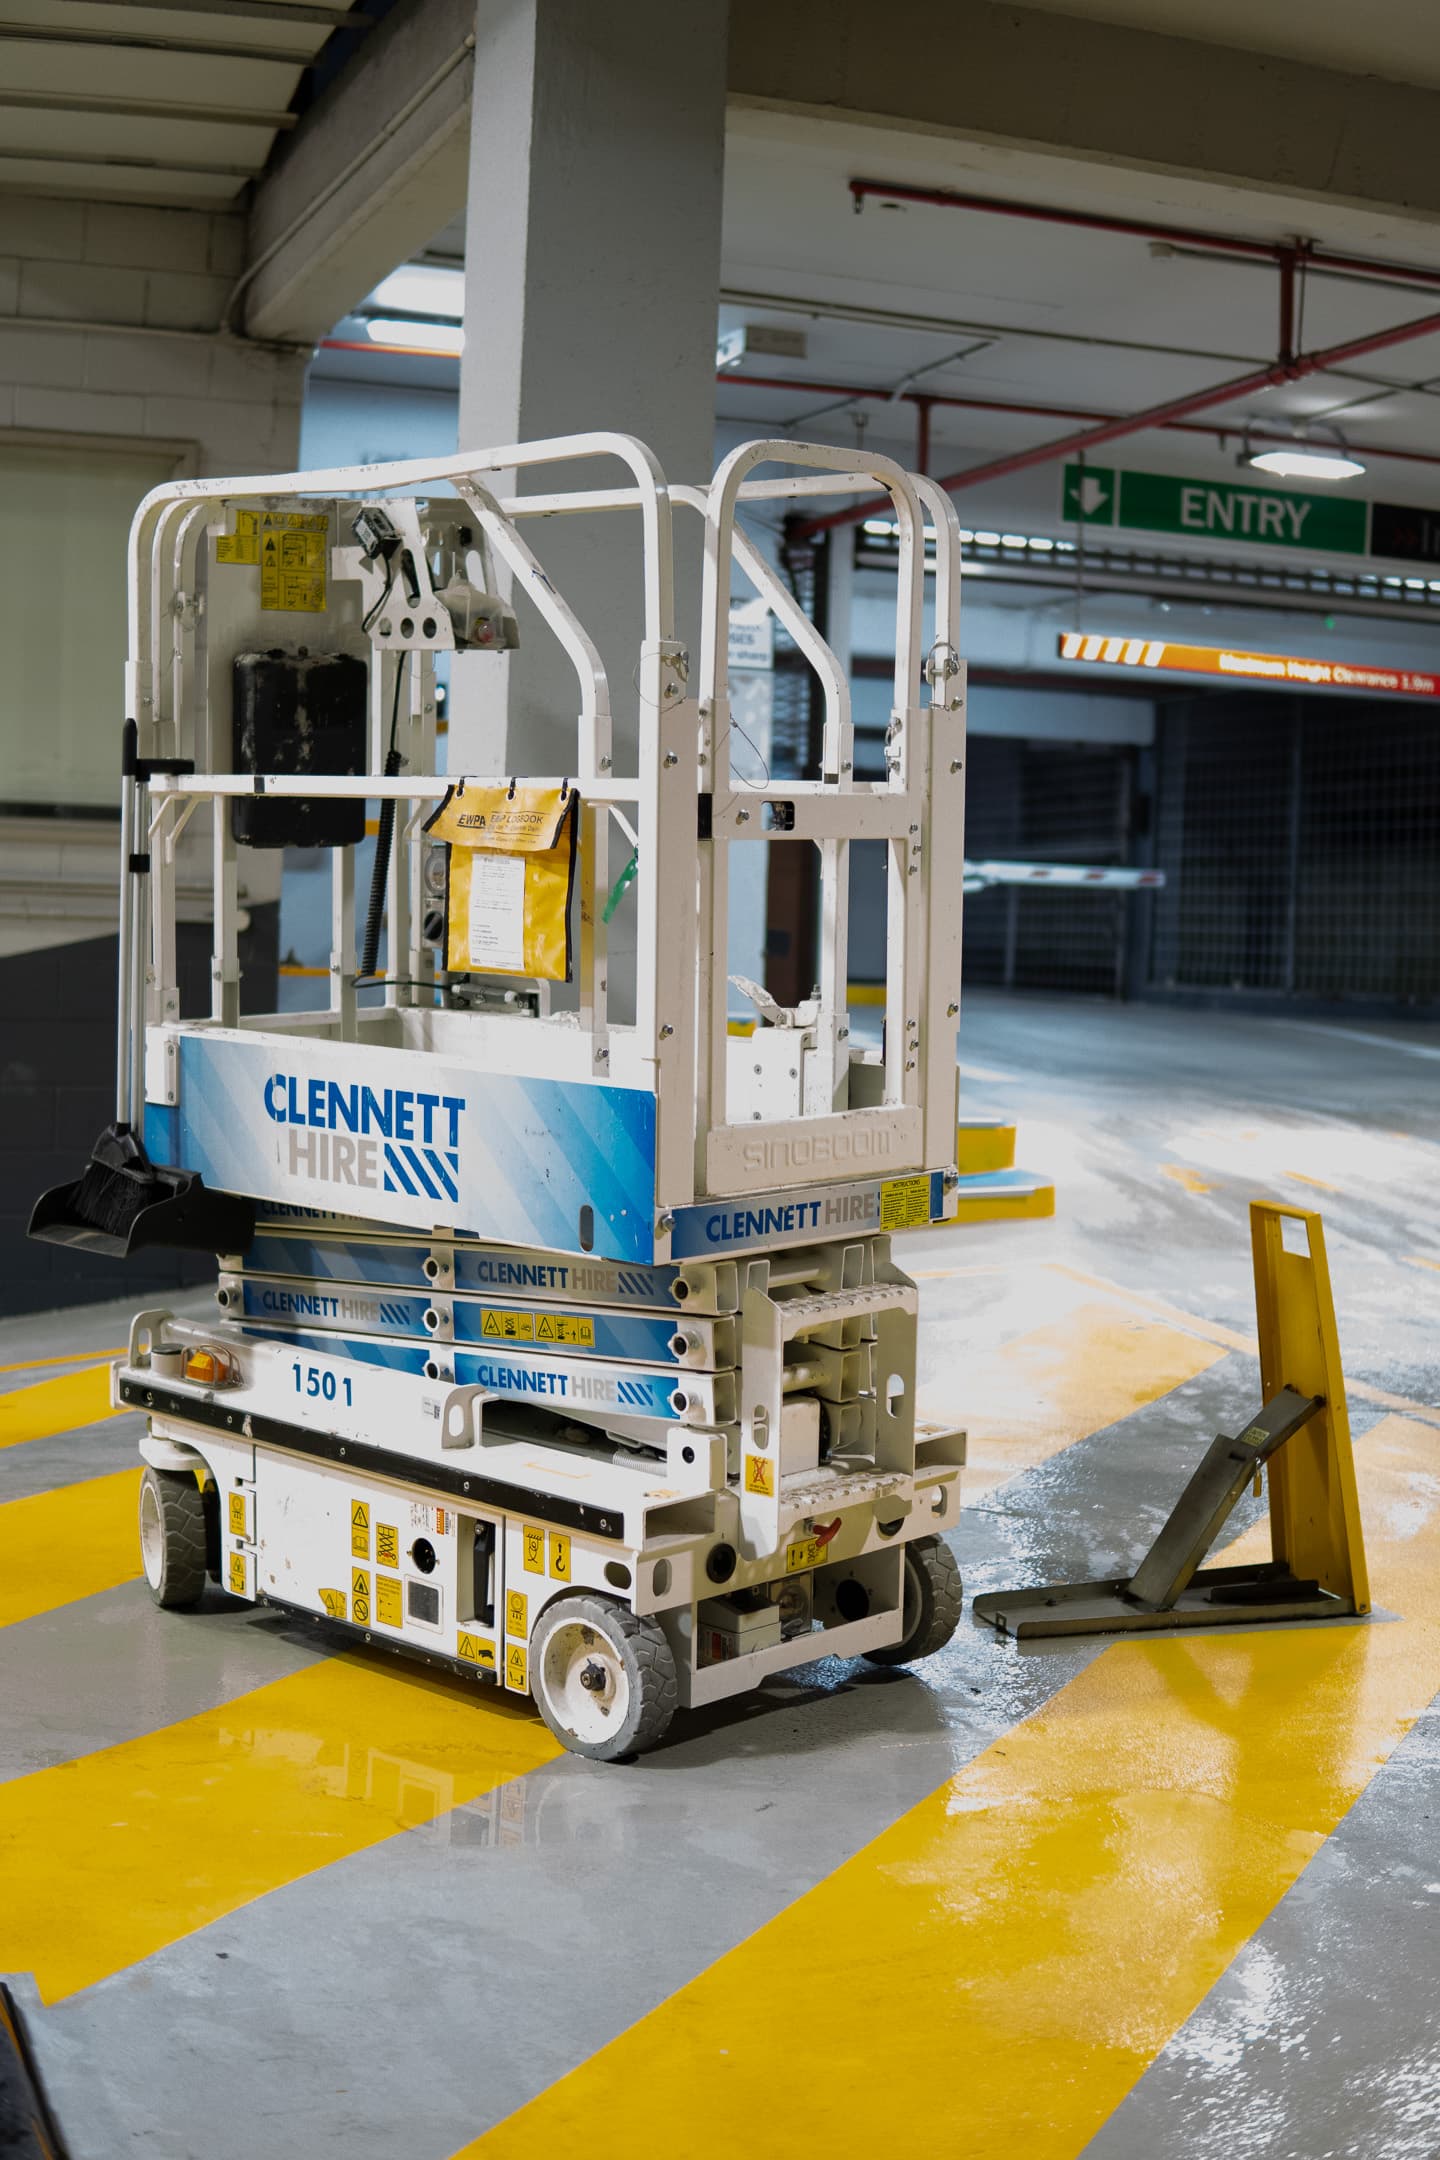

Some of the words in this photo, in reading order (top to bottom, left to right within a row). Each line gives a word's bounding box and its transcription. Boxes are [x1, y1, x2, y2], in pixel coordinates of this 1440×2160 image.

[1180, 486, 1313, 540] ENTRY
[1287, 660, 1332, 683] Height
[1333, 666, 1399, 689] Clearance
[457, 813, 487, 827] EWPA
[264, 1074, 466, 1148] CLENNETT
[289, 1129, 378, 1190] HIRE
[743, 1127, 892, 1173] SINOBOOM
[892, 1179, 921, 1189] INSTRUCTIONS
[706, 1200, 822, 1243] CLENNETT
[825, 1191, 876, 1225] HIRE
[477, 1260, 569, 1288] CLENNETT
[572, 1268, 618, 1296] HIRE
[262, 1290, 339, 1318] CLENNETT
[341, 1296, 380, 1322] HIRE
[292, 1363, 353, 1407] 1501
[477, 1365, 569, 1396] CLENNETT
[571, 1375, 618, 1401] HIRE
